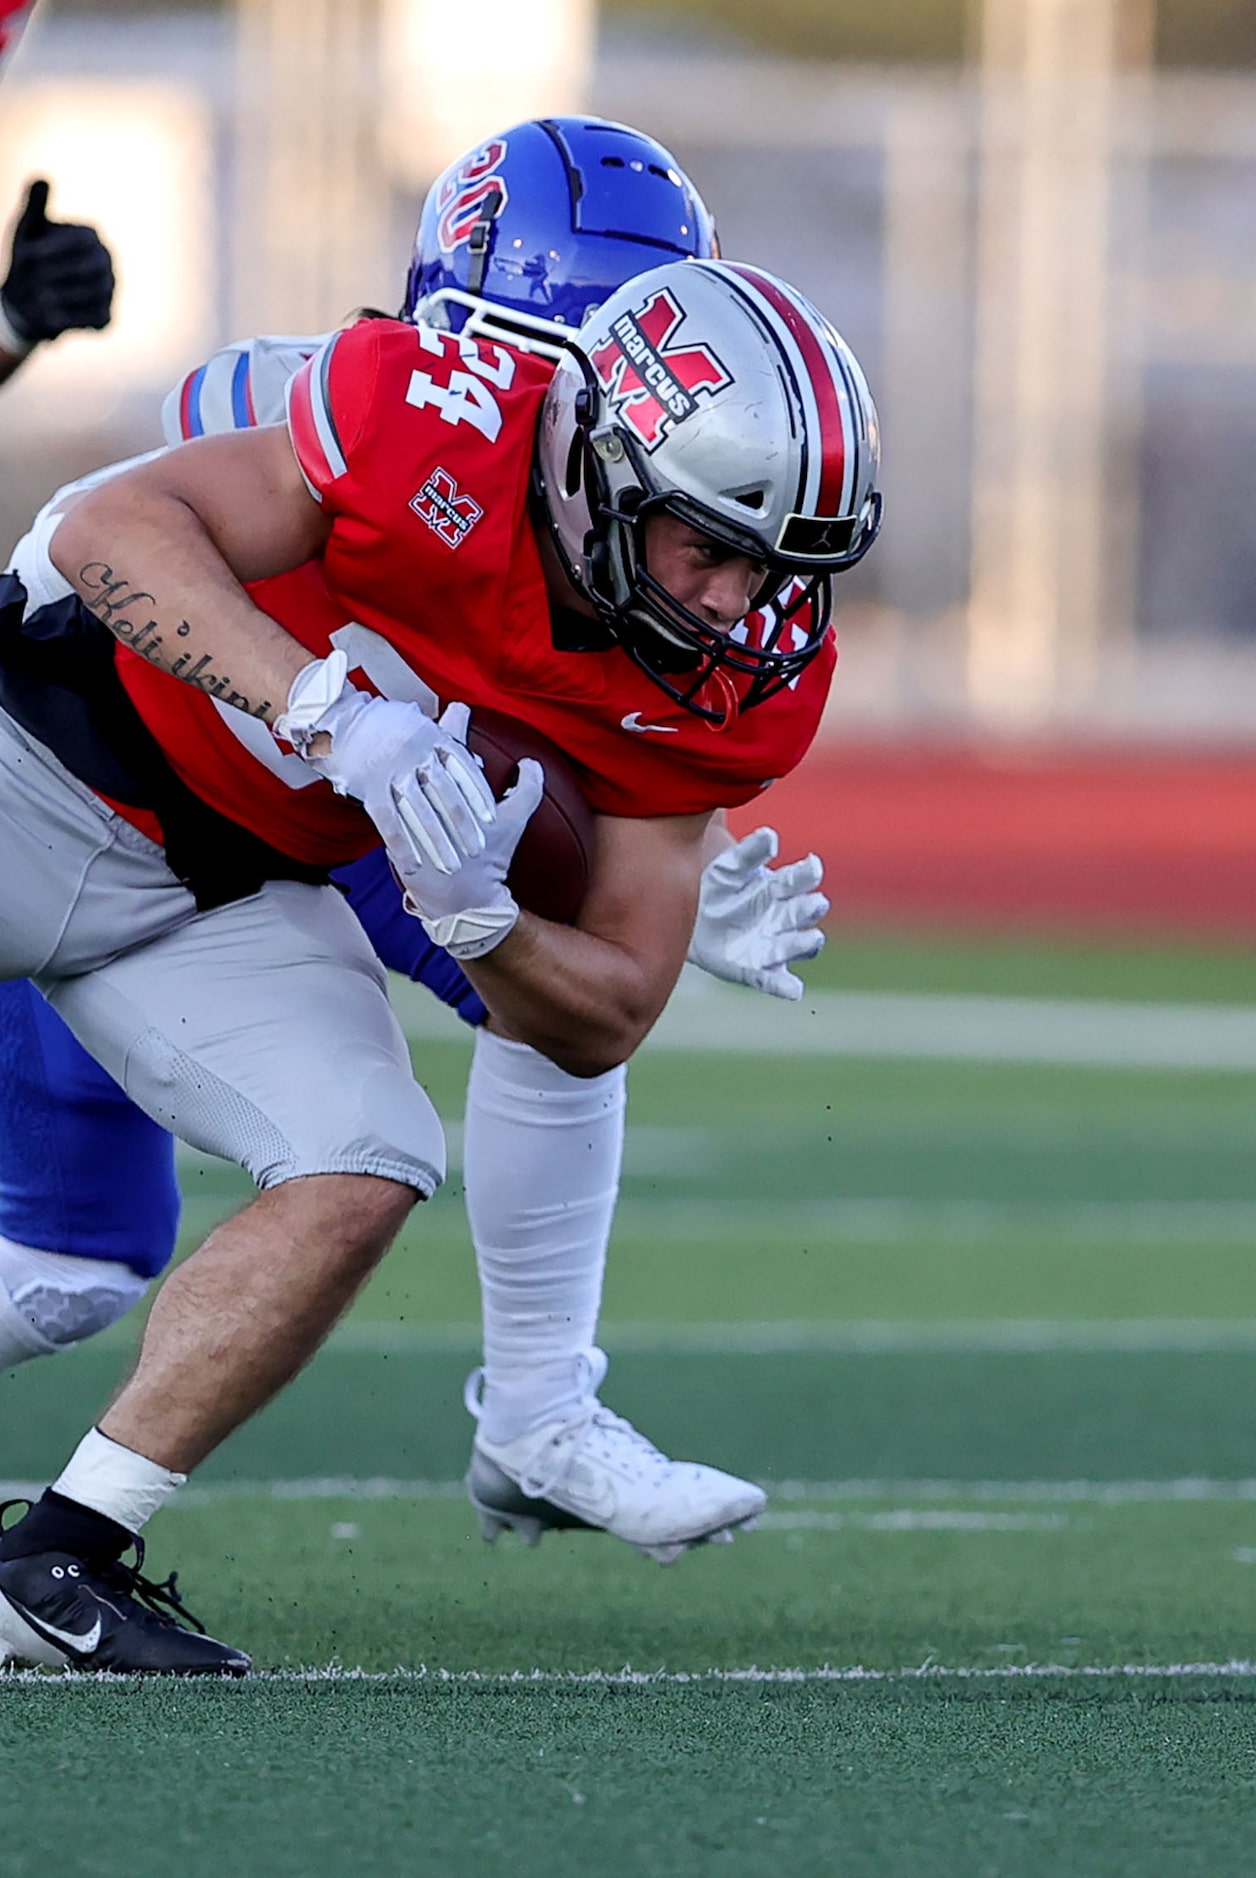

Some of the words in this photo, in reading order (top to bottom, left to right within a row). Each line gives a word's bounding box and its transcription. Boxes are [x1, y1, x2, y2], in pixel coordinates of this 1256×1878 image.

[405, 325, 517, 444] 24
[613, 314, 691, 417] marcus
[424, 485, 470, 532] marcus
